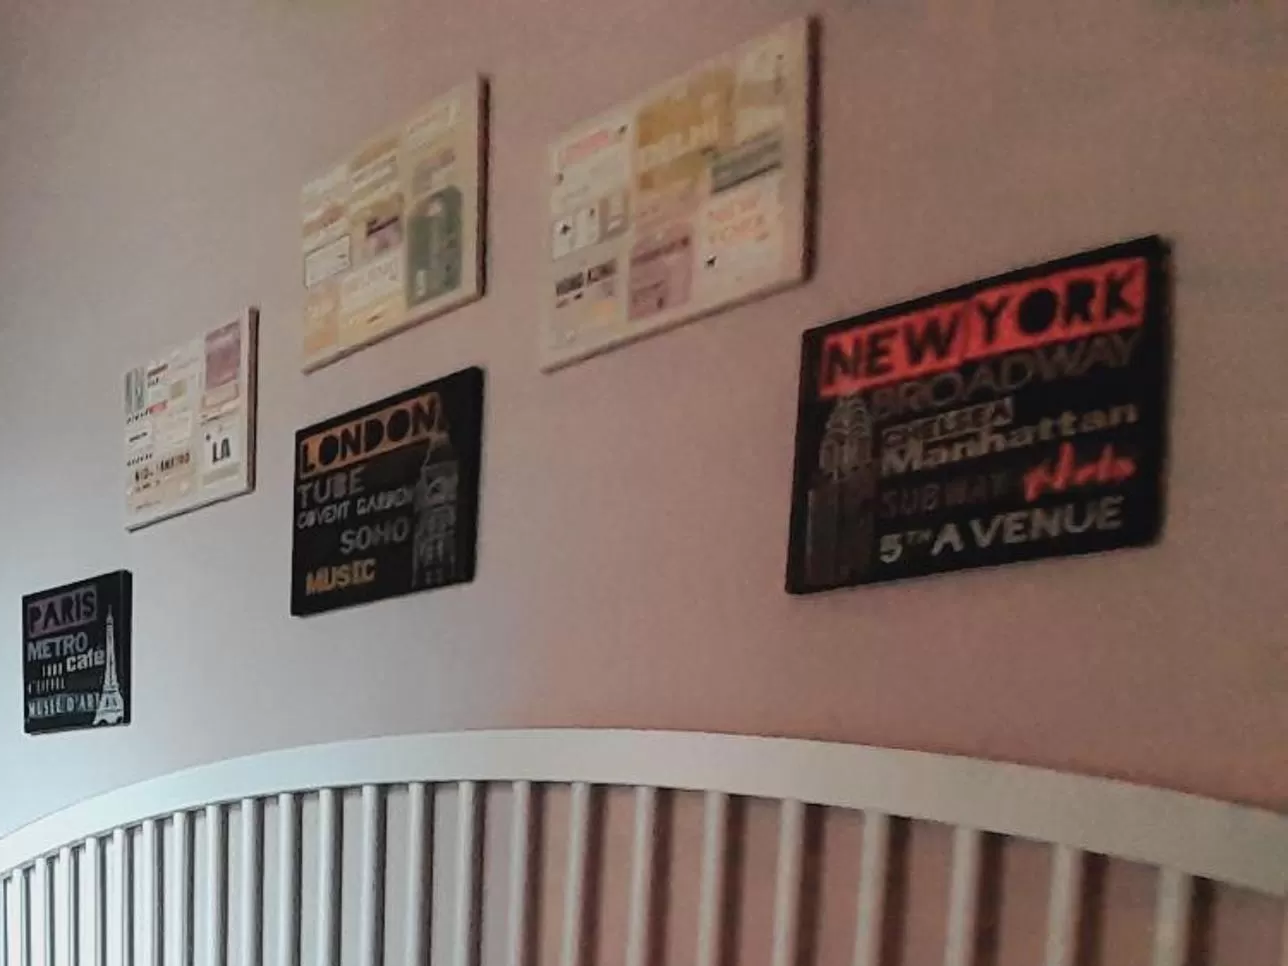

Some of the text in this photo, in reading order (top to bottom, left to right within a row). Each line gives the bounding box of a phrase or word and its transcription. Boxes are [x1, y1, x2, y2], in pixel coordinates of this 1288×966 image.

[824, 268, 1137, 387] NEW YORK
[870, 331, 1141, 417] BROADWAY
[301, 397, 439, 475] LONDON
[881, 402, 1139, 478] Manhattan
[296, 466, 364, 508] TUBE
[339, 517, 411, 555] SOHO
[931, 495, 1125, 556] AVENUE
[305, 558, 377, 596] MUSIC
[29, 589, 96, 633] PARIS
[27, 632, 88, 662] METRO
